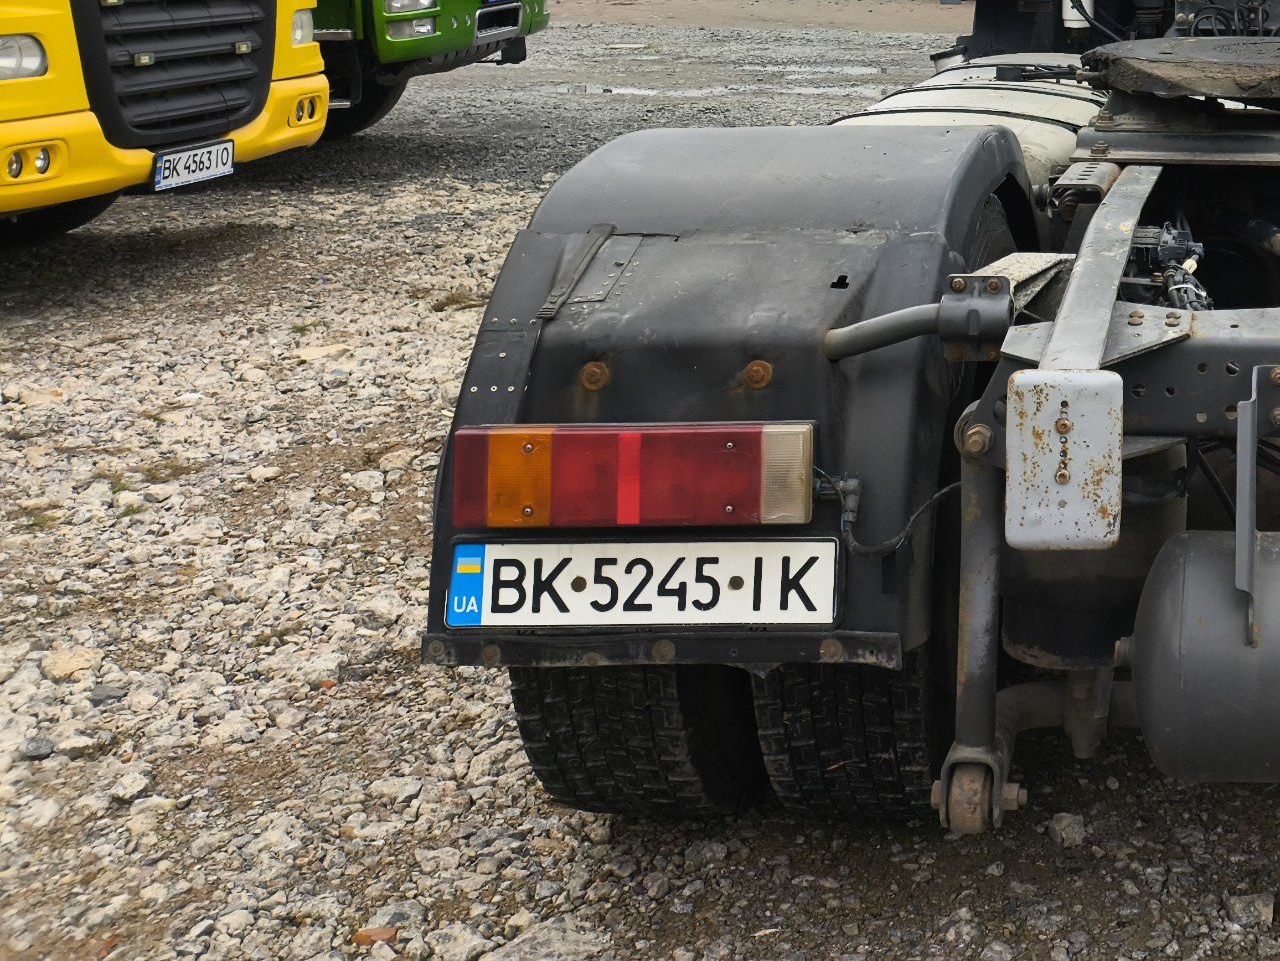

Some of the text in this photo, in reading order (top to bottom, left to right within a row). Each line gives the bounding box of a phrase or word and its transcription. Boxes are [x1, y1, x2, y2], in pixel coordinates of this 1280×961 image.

[162, 157, 181, 180] BK
[184, 150, 212, 175] 4563
[453, 556, 820, 614] UA BK 5245 IK
